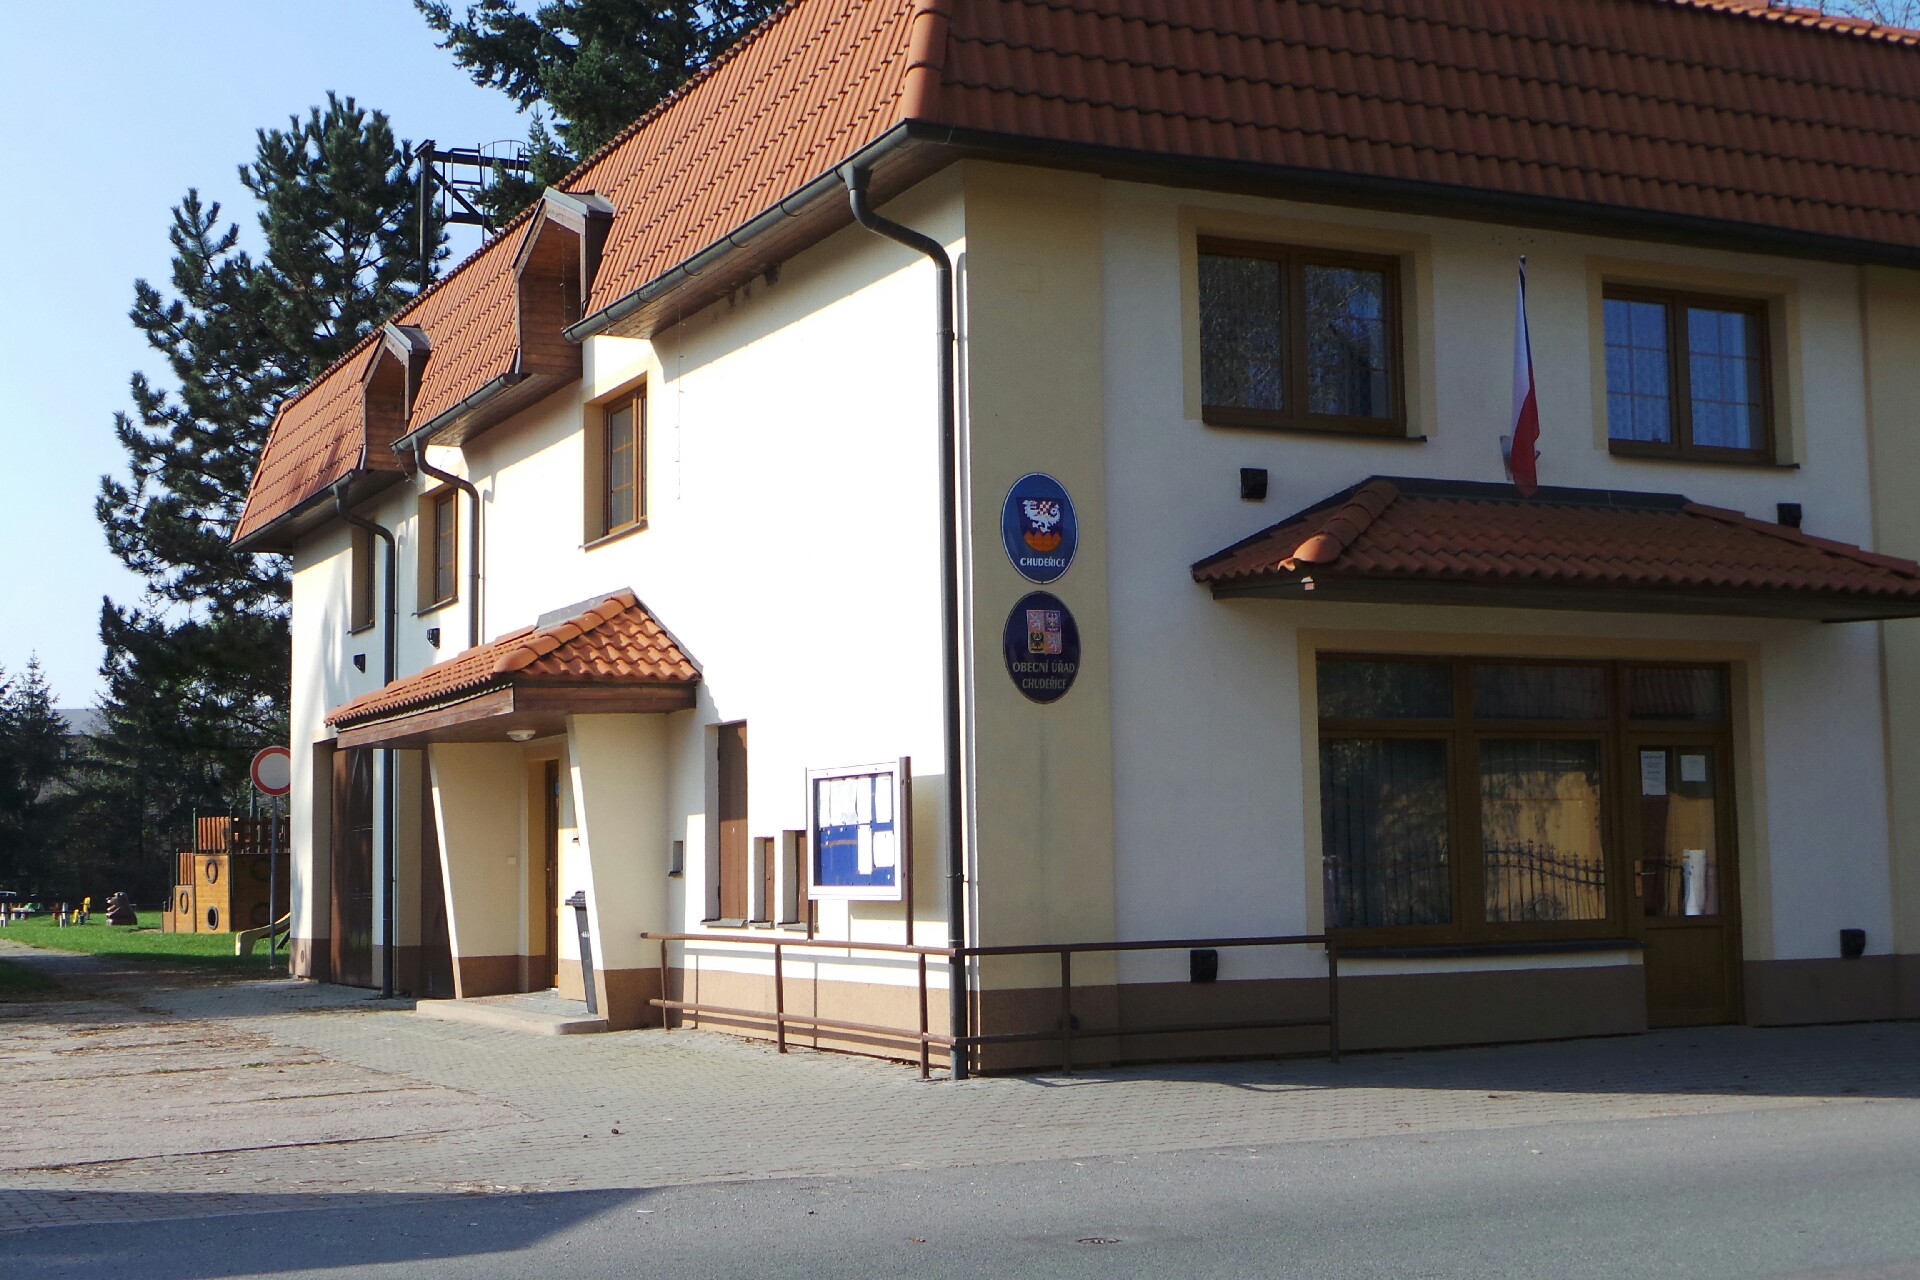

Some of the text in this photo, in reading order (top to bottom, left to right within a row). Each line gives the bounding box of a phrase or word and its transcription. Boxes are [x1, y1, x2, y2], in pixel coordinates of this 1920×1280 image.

[1020, 556, 1065, 567] CHUDEŘICE
[1012, 659, 1075, 673] OBECNÍ ÚŘAD
[1022, 676, 1066, 689] CHUDEŘICE
